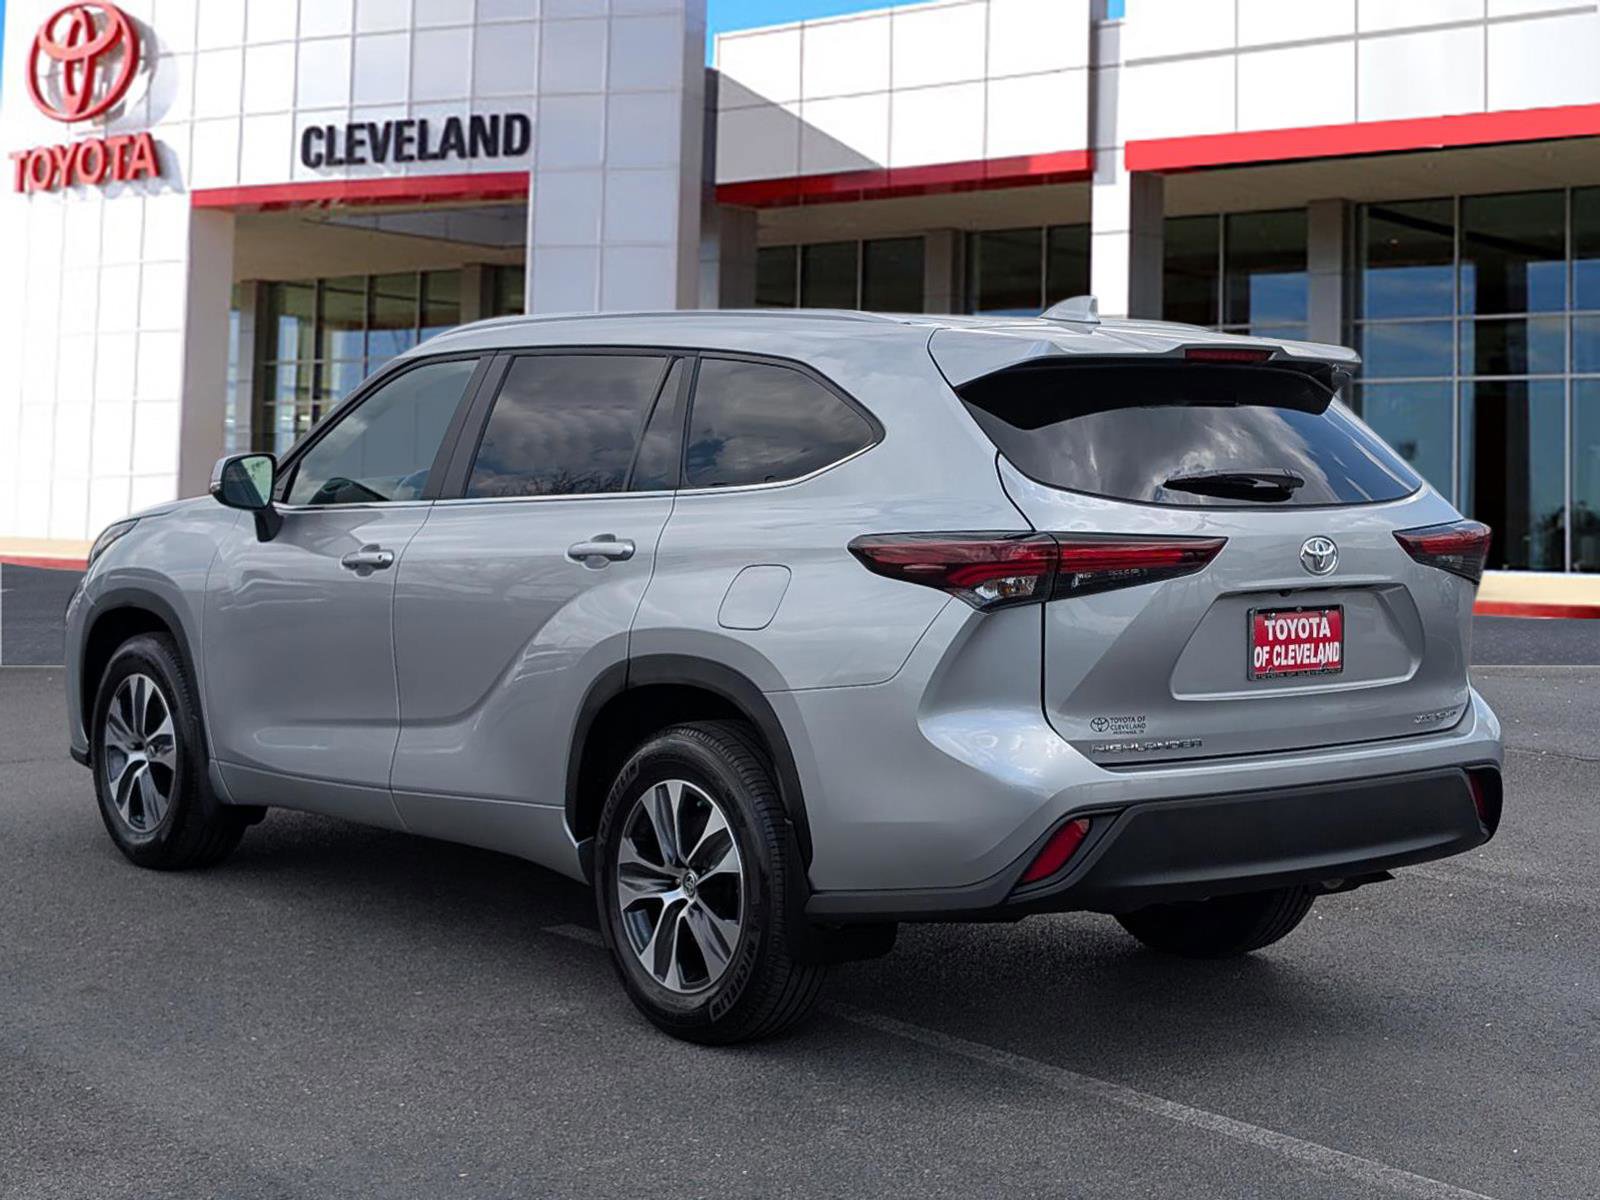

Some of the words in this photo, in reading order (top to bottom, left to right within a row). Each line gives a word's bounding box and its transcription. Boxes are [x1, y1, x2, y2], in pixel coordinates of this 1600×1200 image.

[301, 113, 531, 169] CLEVELAND
[8, 131, 160, 193] TOYOTA
[1264, 617, 1331, 641] TOYOTA
[1254, 646, 1270, 668] OF
[1273, 641, 1340, 667] CLEVELAND
[1109, 716, 1136, 724] TOYOTA
[1137, 715, 1146, 723] OF
[1110, 722, 1147, 731] CLEVELAND
